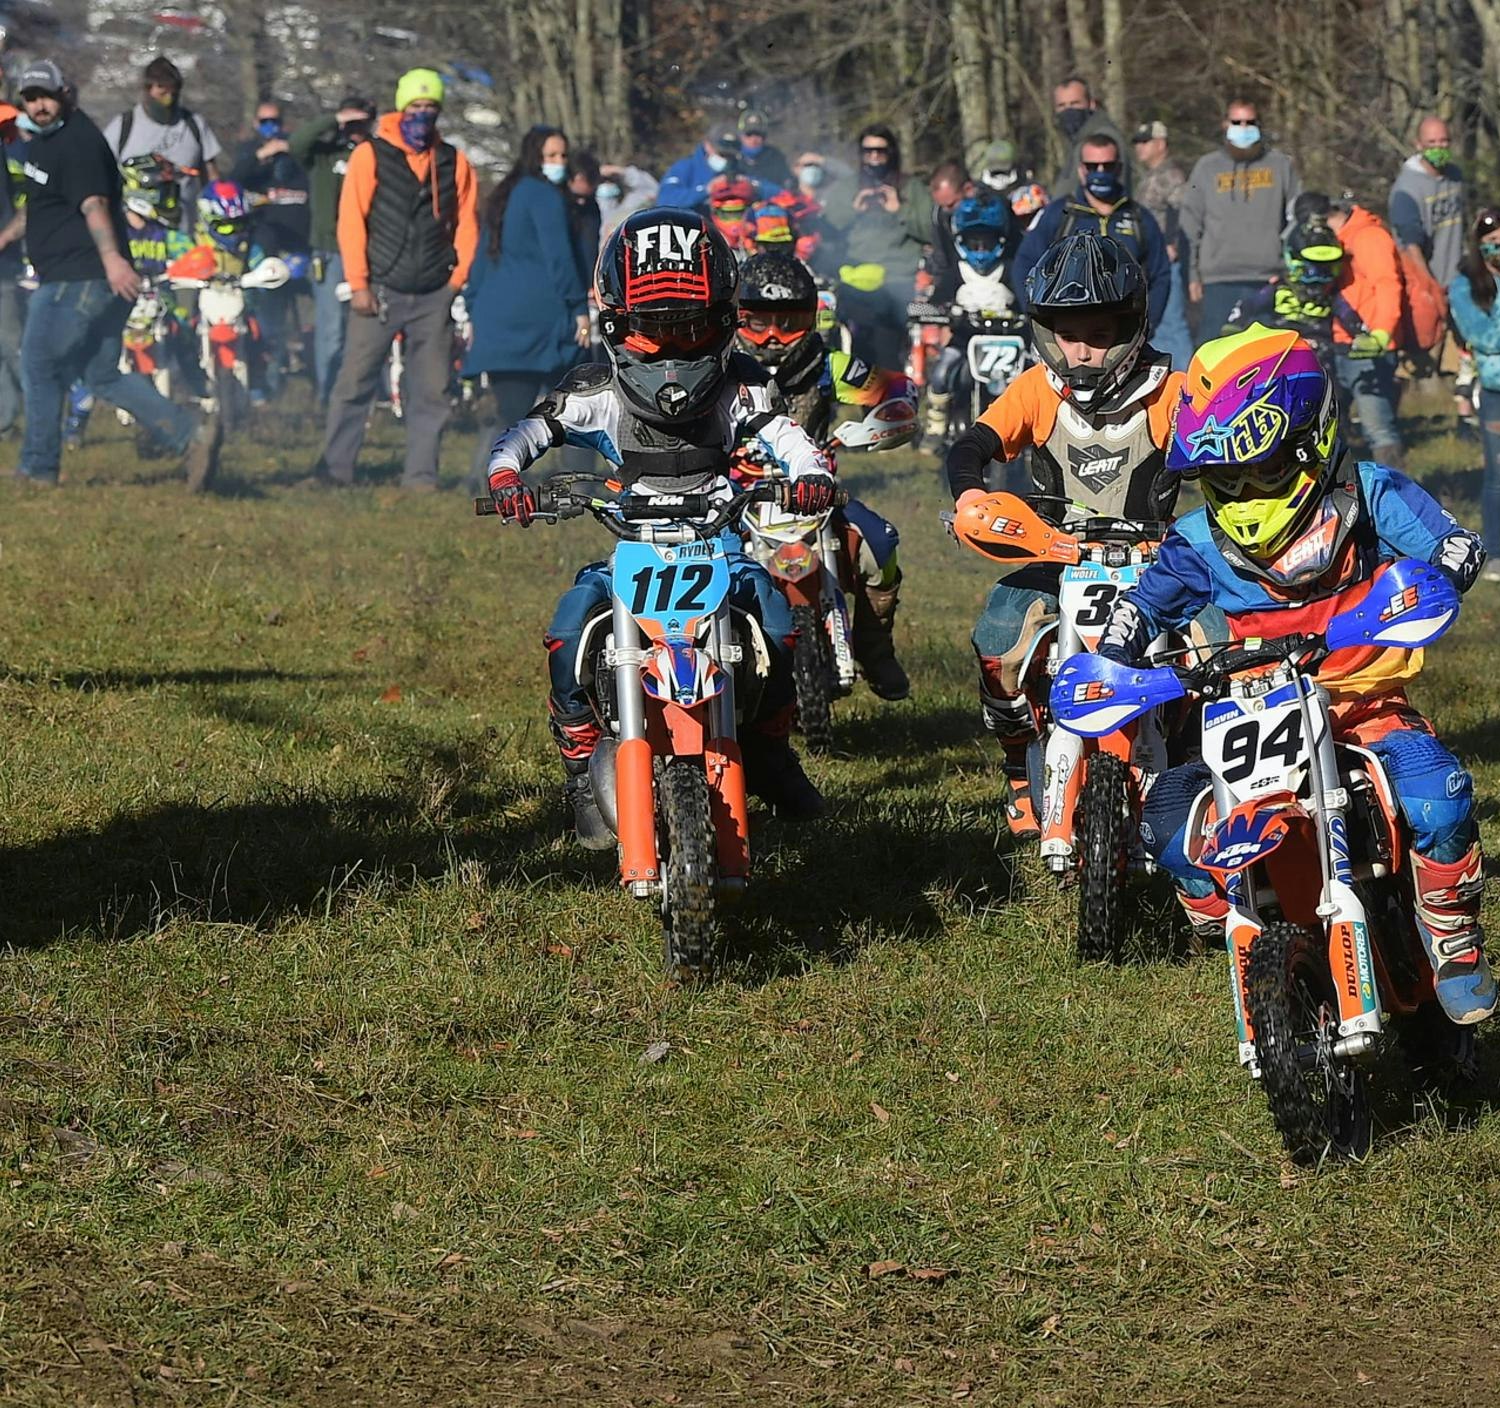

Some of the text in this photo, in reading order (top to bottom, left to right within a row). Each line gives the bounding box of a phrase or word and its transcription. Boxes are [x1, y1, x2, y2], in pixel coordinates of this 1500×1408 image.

[636, 224, 700, 264] FLY
[979, 345, 1018, 372] 72
[1078, 456, 1123, 477] LEATT
[648, 496, 684, 506] KTM
[678, 543, 716, 559] RYDER
[631, 563, 714, 615] 112
[1076, 584, 1126, 627] 3
[1205, 708, 1239, 729] GAVIN
[1222, 708, 1304, 785] 94
[1214, 842, 1262, 864] KTM
[1341, 925, 1358, 998] DUNLOP
[1354, 924, 1371, 983] MOTOREX
